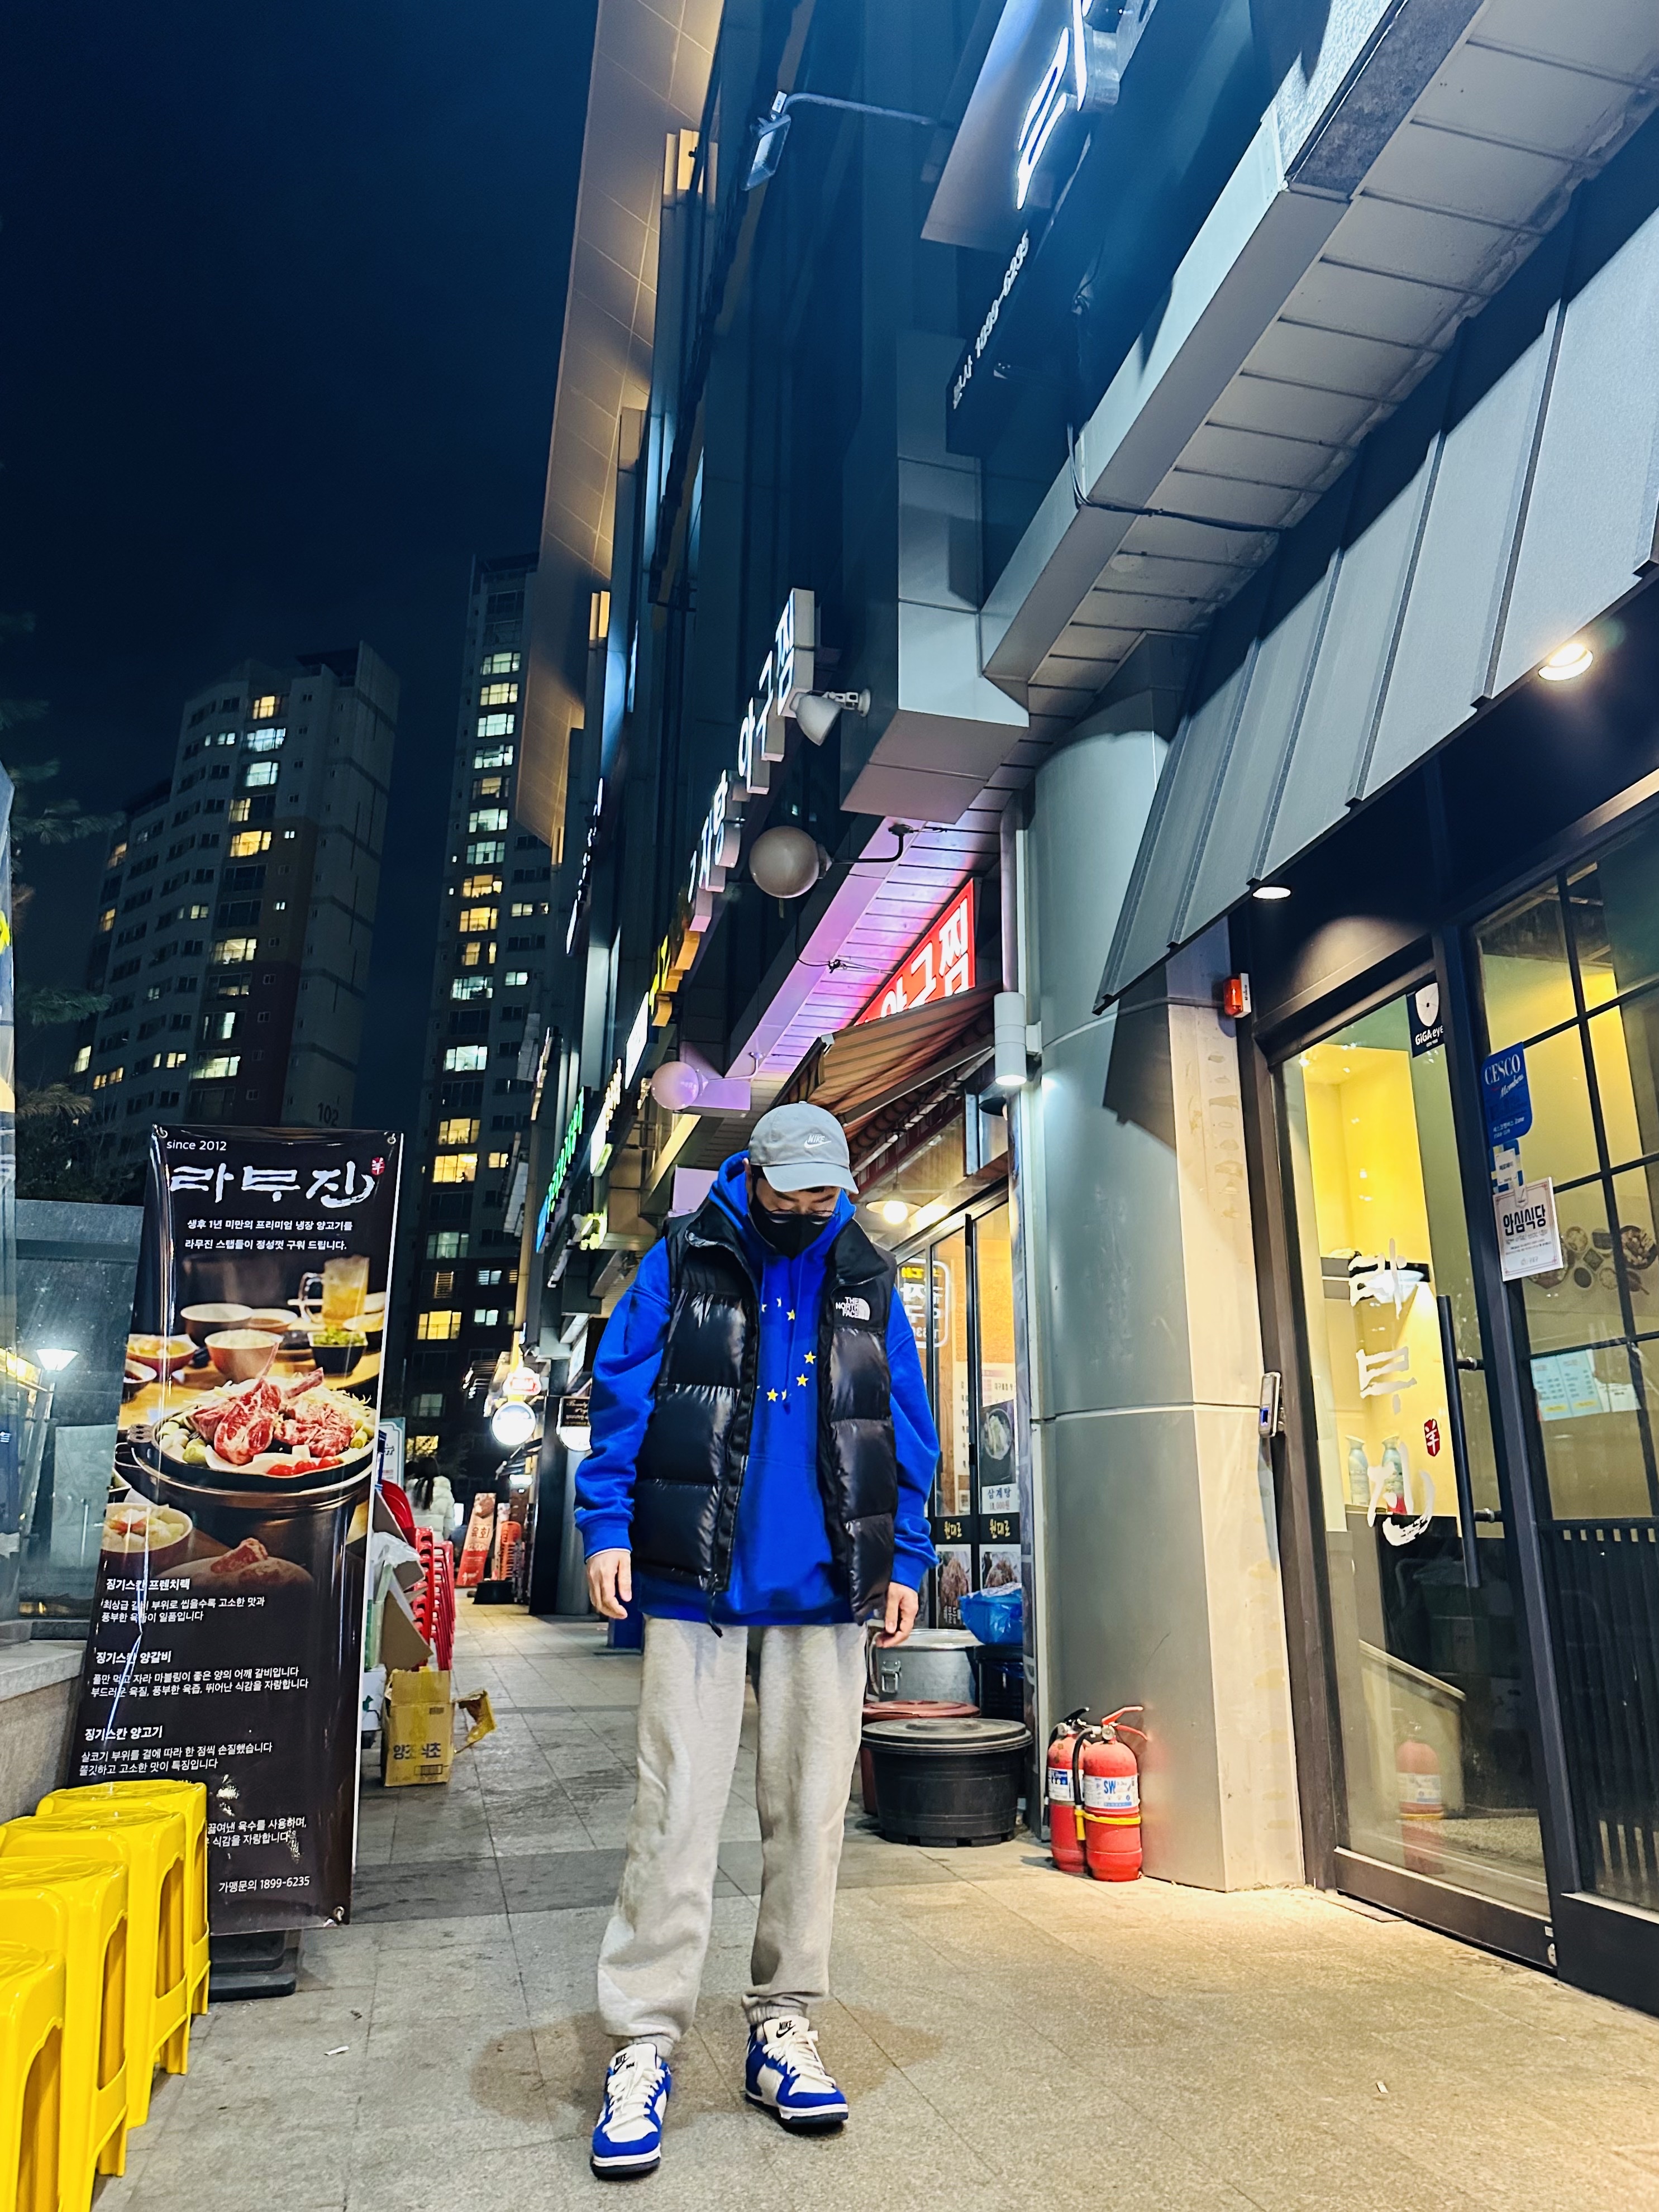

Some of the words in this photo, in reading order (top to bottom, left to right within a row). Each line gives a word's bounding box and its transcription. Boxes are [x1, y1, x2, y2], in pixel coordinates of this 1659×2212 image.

[1484, 1053, 1520, 1085] CESCO
[808, 1134, 826, 1143] NIKE
[166, 1141, 196, 1150] since
[199, 1140, 227, 1151] 2012
[170, 1161, 375, 1208] 라무진
[187, 1219, 207, 1229] 생후
[209, 1219, 222, 1229] 1년
[225, 1219, 254, 1230] 미만의
[255, 1219, 293, 1230] 프리미엄
[295, 1220, 314, 1231] 냉장
[316, 1221, 353, 1231] 양고기를
[1503, 1204, 1547, 1237] 안심식당
[185, 1238, 213, 1249] 라무진
[256, 1240, 284, 1250] 정성껏
[287, 1240, 306, 1250] 구워
[307, 1240, 347, 1251] 드립니다.
[835, 1302, 859, 1311] NORTH
[842, 1309, 859, 1318] FACE
[1425, 1420, 1439, 1455] 羊
[988, 1486, 1012, 1499] 삼계탕
[471, 1527, 490, 1538] 육회
[106, 1578, 146, 1591] 징기스칸
[148, 1578, 190, 1591] 프렌치랙
[103, 1599, 129, 1610] 최상급
[151, 1599, 178, 1610] 부위로
[180, 1598, 216, 1609] 씹을수록
[218, 1596, 245, 1608] 고소한
[247, 1596, 265, 1607] 맛과
[102, 1612, 128, 1623] 풍부한
[159, 1610, 204, 1622] 일품입니다
[140, 1650, 171, 1663] 양갈비
[93, 1674, 111, 1685] 풀만
[133, 1673, 152, 1684] 자라
[154, 1671, 191, 1683] 마블링이
[193, 1670, 212, 1682] 좋은
[214, 1669, 232, 1680] 양의
[234, 1668, 252, 1680] 어깨
[255, 1666, 299, 1679] 갈비입니다
[91, 1687, 127, 1698] 부드러운
[129, 1686, 149, 1697] 육질,
[152, 1684, 180, 1696] 풍부한
[182, 1682, 203, 1694] 육즙,
[206, 1681, 233, 1694] 뛰어난
[235, 1680, 262, 1692] 식감을
[264, 1677, 309, 1690] 자랑합니다
[85, 1728, 127, 1742] 징기스칸
[130, 1725, 163, 1739] 양고기
[81, 1751, 108, 1762] 살코기
[111, 1749, 140, 1762] 부위를
[142, 1747, 161, 1760] 결에
[163, 1746, 183, 1758] 따라
[185, 1746, 194, 1758] 한
[197, 1744, 216, 1757] 점씩
[218, 1742, 273, 1756] 손질했습니다
[79, 1763, 116, 1776] 쫄깃하고
[118, 1761, 147, 1774] 고소한
[150, 1760, 169, 1773] 맛이
[171, 1758, 218, 1771] 특징입니다
[207, 1822, 236, 1835] 끓여낸
[238, 1819, 266, 1832] 육수를
[268, 1816, 307, 1830] 사용하며,
[212, 1835, 241, 1848] 식감을
[242, 1830, 289, 1845] 자랑합니다
[218, 1879, 258, 1894] 가맹문의
[260, 1875, 311, 1890] 1899-6235
[779, 2020, 793, 2030] NIKE
[616, 2053, 627, 2066] NIKE
